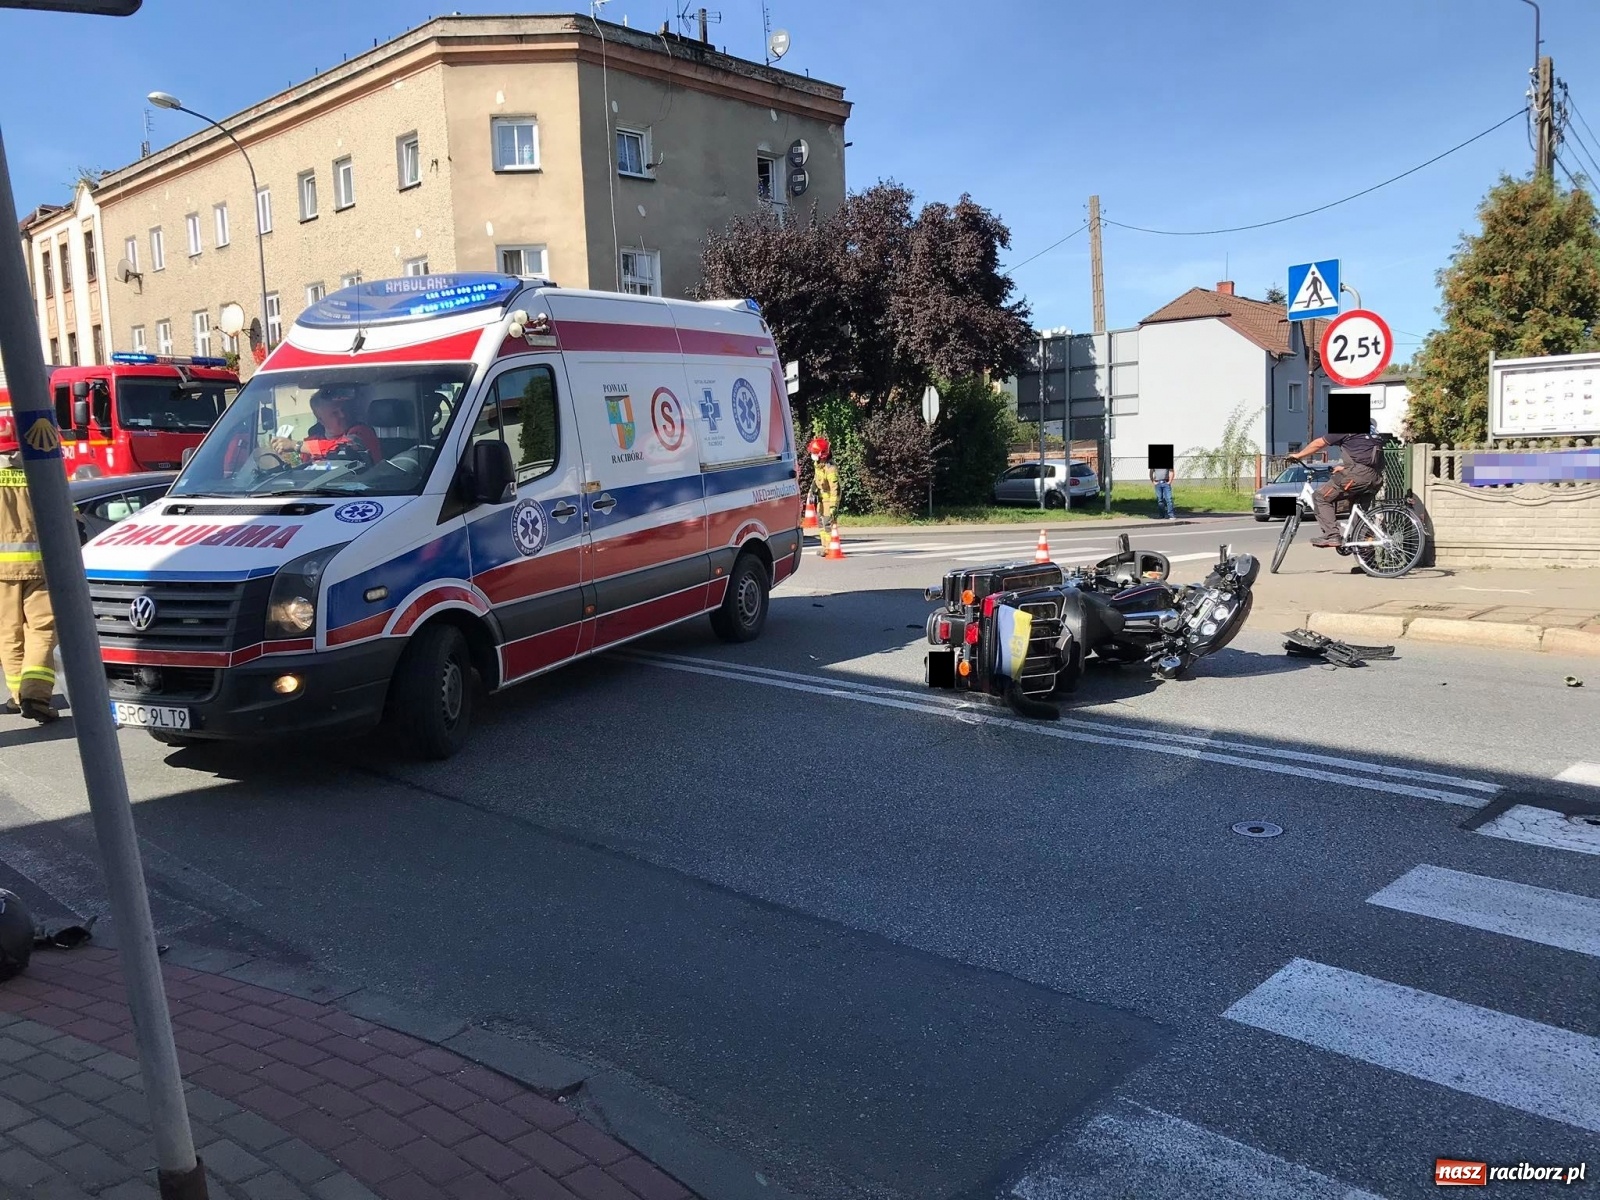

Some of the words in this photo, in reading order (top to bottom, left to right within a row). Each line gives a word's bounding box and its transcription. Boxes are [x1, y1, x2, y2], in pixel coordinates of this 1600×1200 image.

[1333, 334, 1381, 364] 2,5t
[602, 383, 628, 393] POWIAT
[661, 401, 676, 438] S
[611, 450, 644, 464] RACIBÓRZ
[118, 704, 147, 724] SRC
[150, 707, 187, 727] 9LT9
